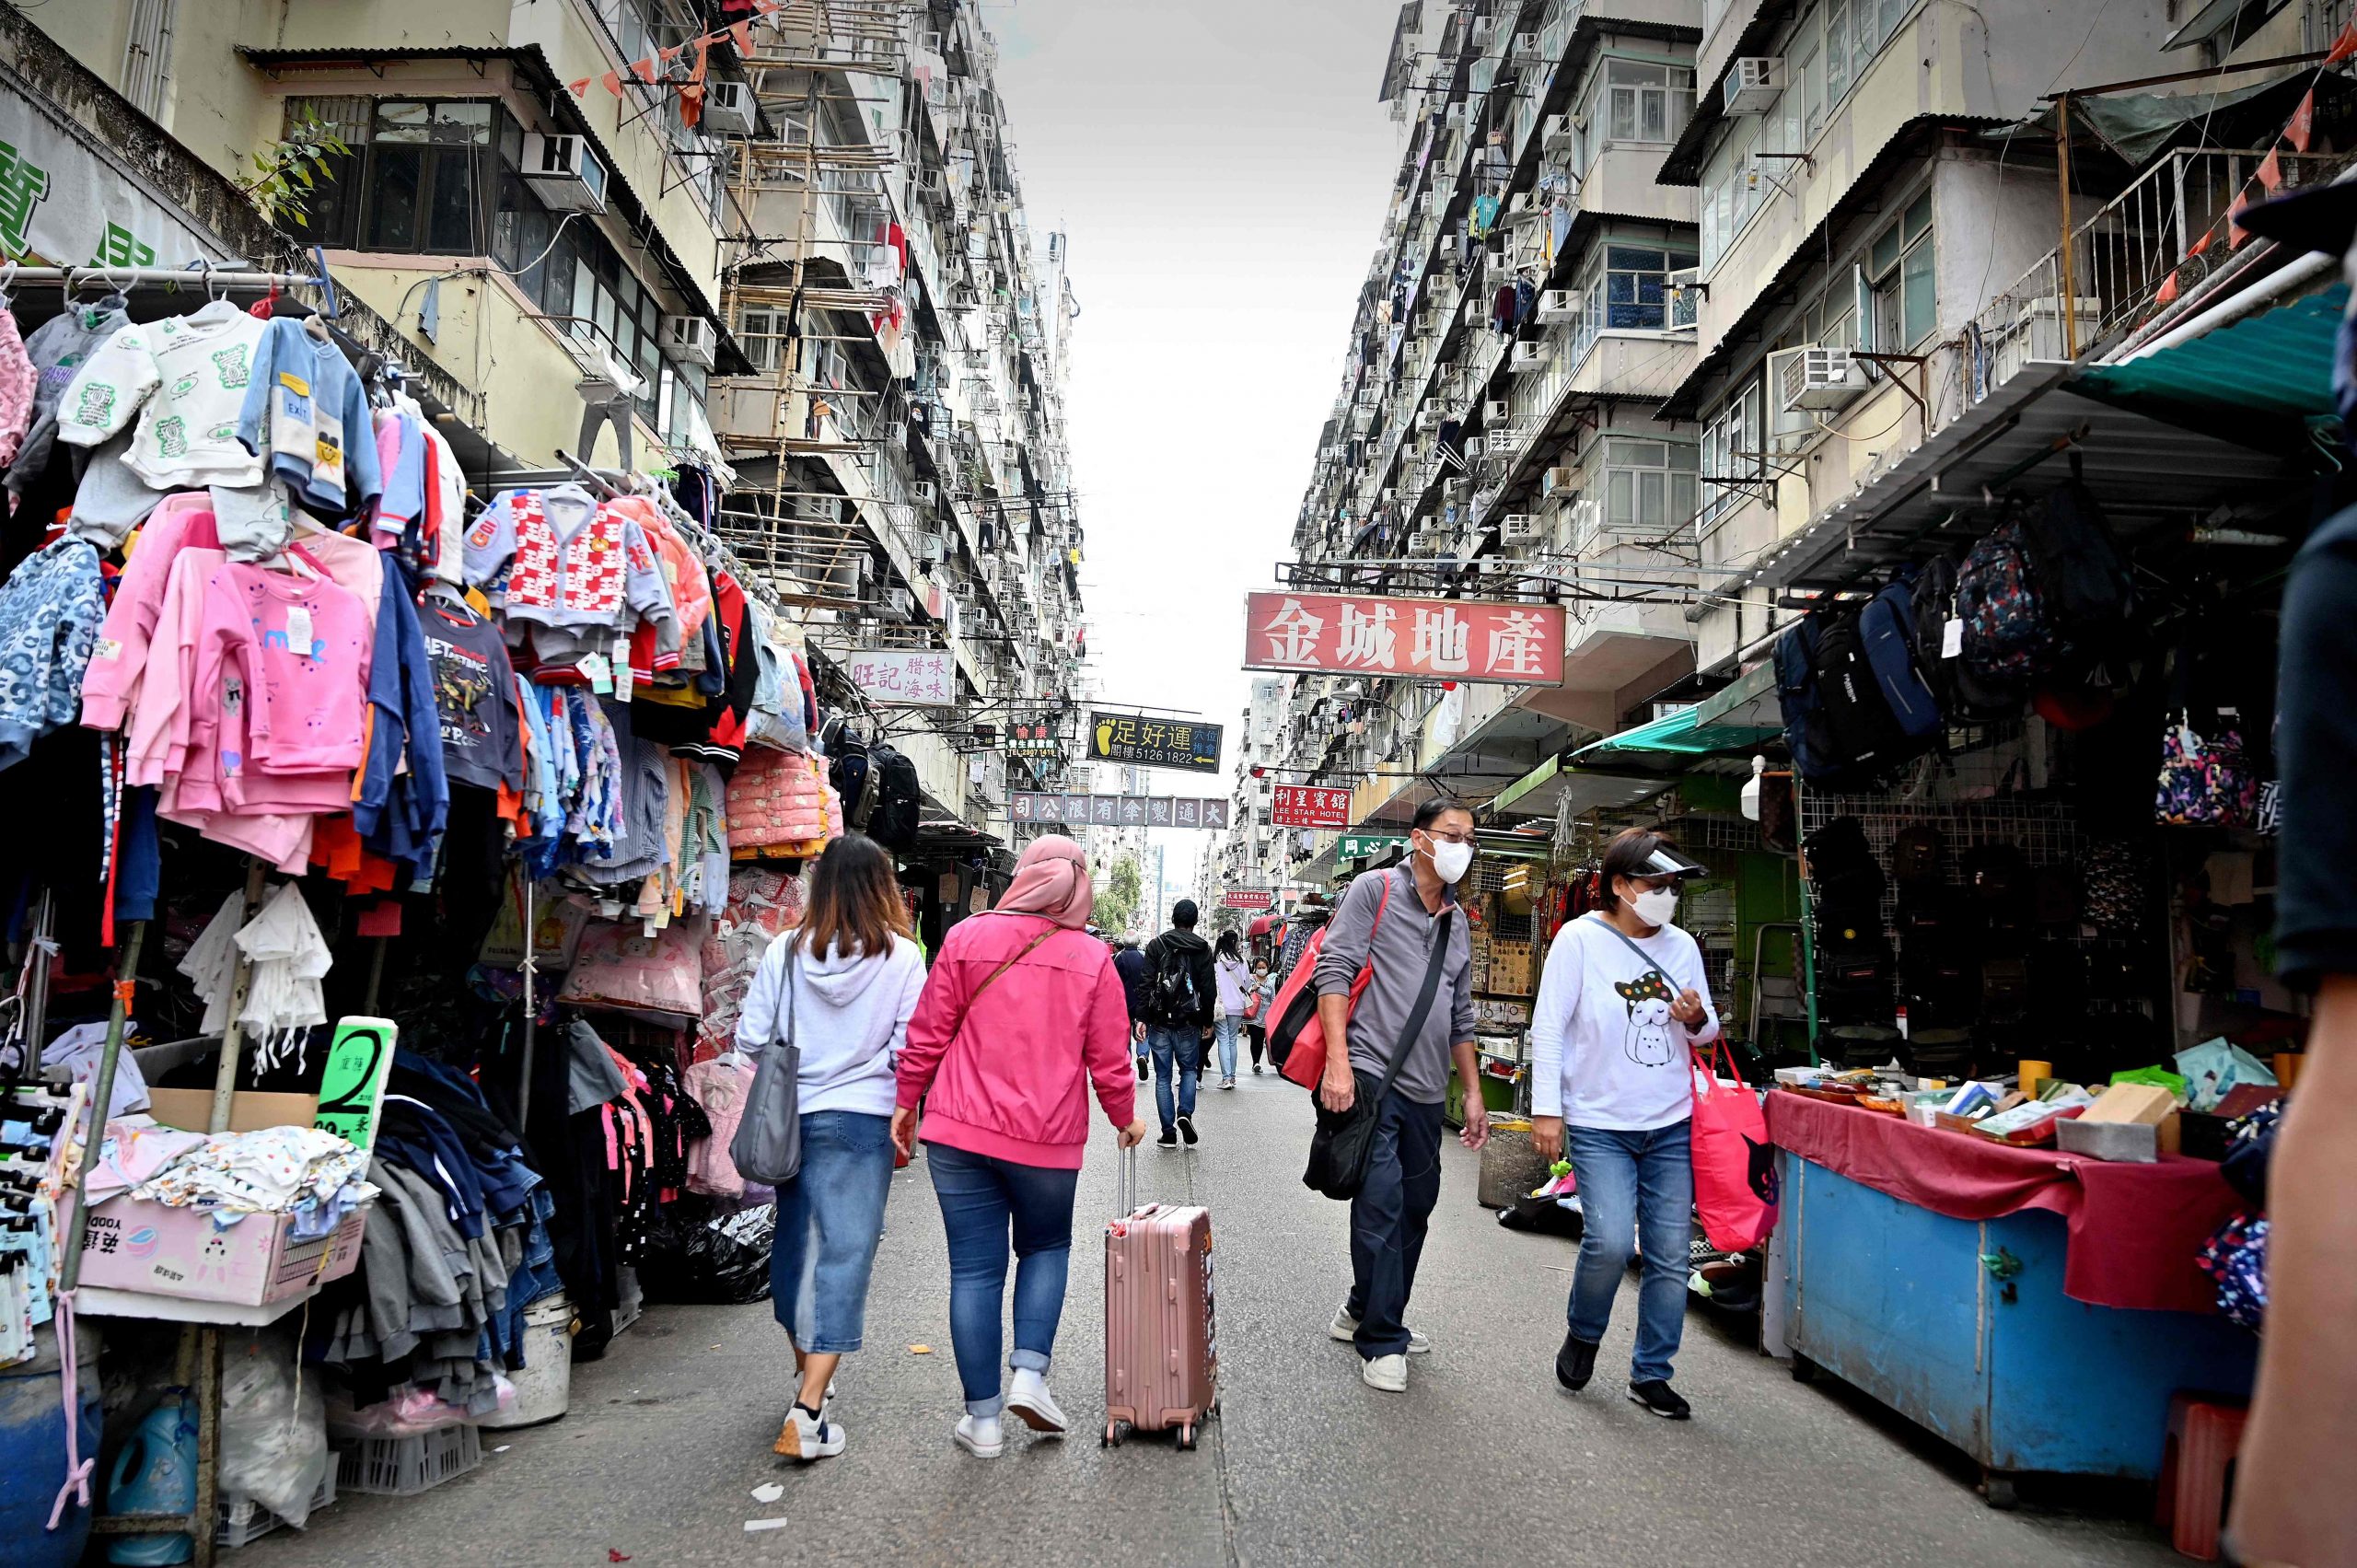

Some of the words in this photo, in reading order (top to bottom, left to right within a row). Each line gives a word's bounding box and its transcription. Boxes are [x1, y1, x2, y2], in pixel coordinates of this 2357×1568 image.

[288, 403, 307, 419] EXIT
[1261, 598, 1546, 675] 金城地產
[853, 662, 901, 691] 旺記
[905, 656, 946, 677] 腊味
[904, 679, 946, 700] 海味
[1016, 726, 1048, 739] 愉康
[1112, 720, 1193, 750] 足好運
[1193, 730, 1216, 742] 穴位
[1135, 748, 1163, 761] 5126
[1167, 751, 1193, 764] 1822
[1275, 788, 1348, 810] 利星賓館
[1294, 808, 1316, 817] STAR
[1319, 810, 1346, 819] HOTEL
[317, 1028, 382, 1114] 2
